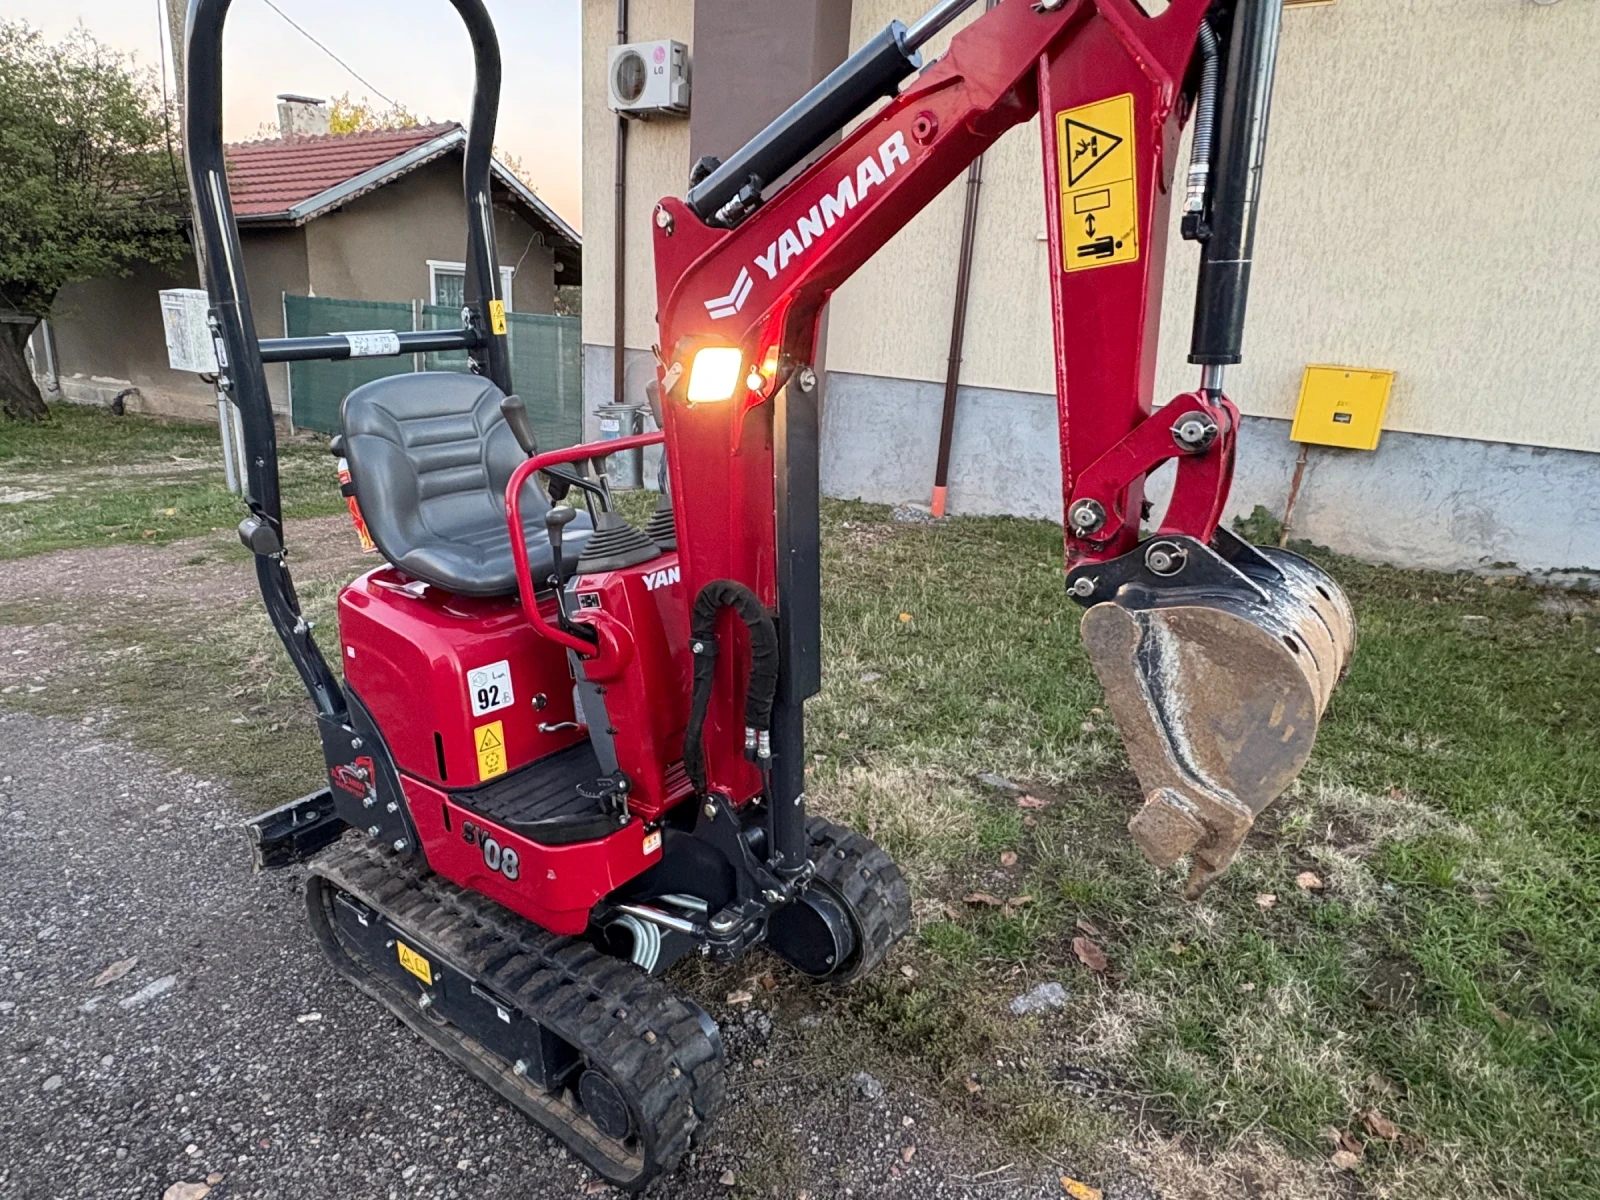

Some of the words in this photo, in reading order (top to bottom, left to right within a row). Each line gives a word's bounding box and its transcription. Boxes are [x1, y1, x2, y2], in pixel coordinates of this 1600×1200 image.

[653, 66, 664, 75] LG
[753, 130, 910, 280] YANMAR
[477, 685, 501, 710] 92
